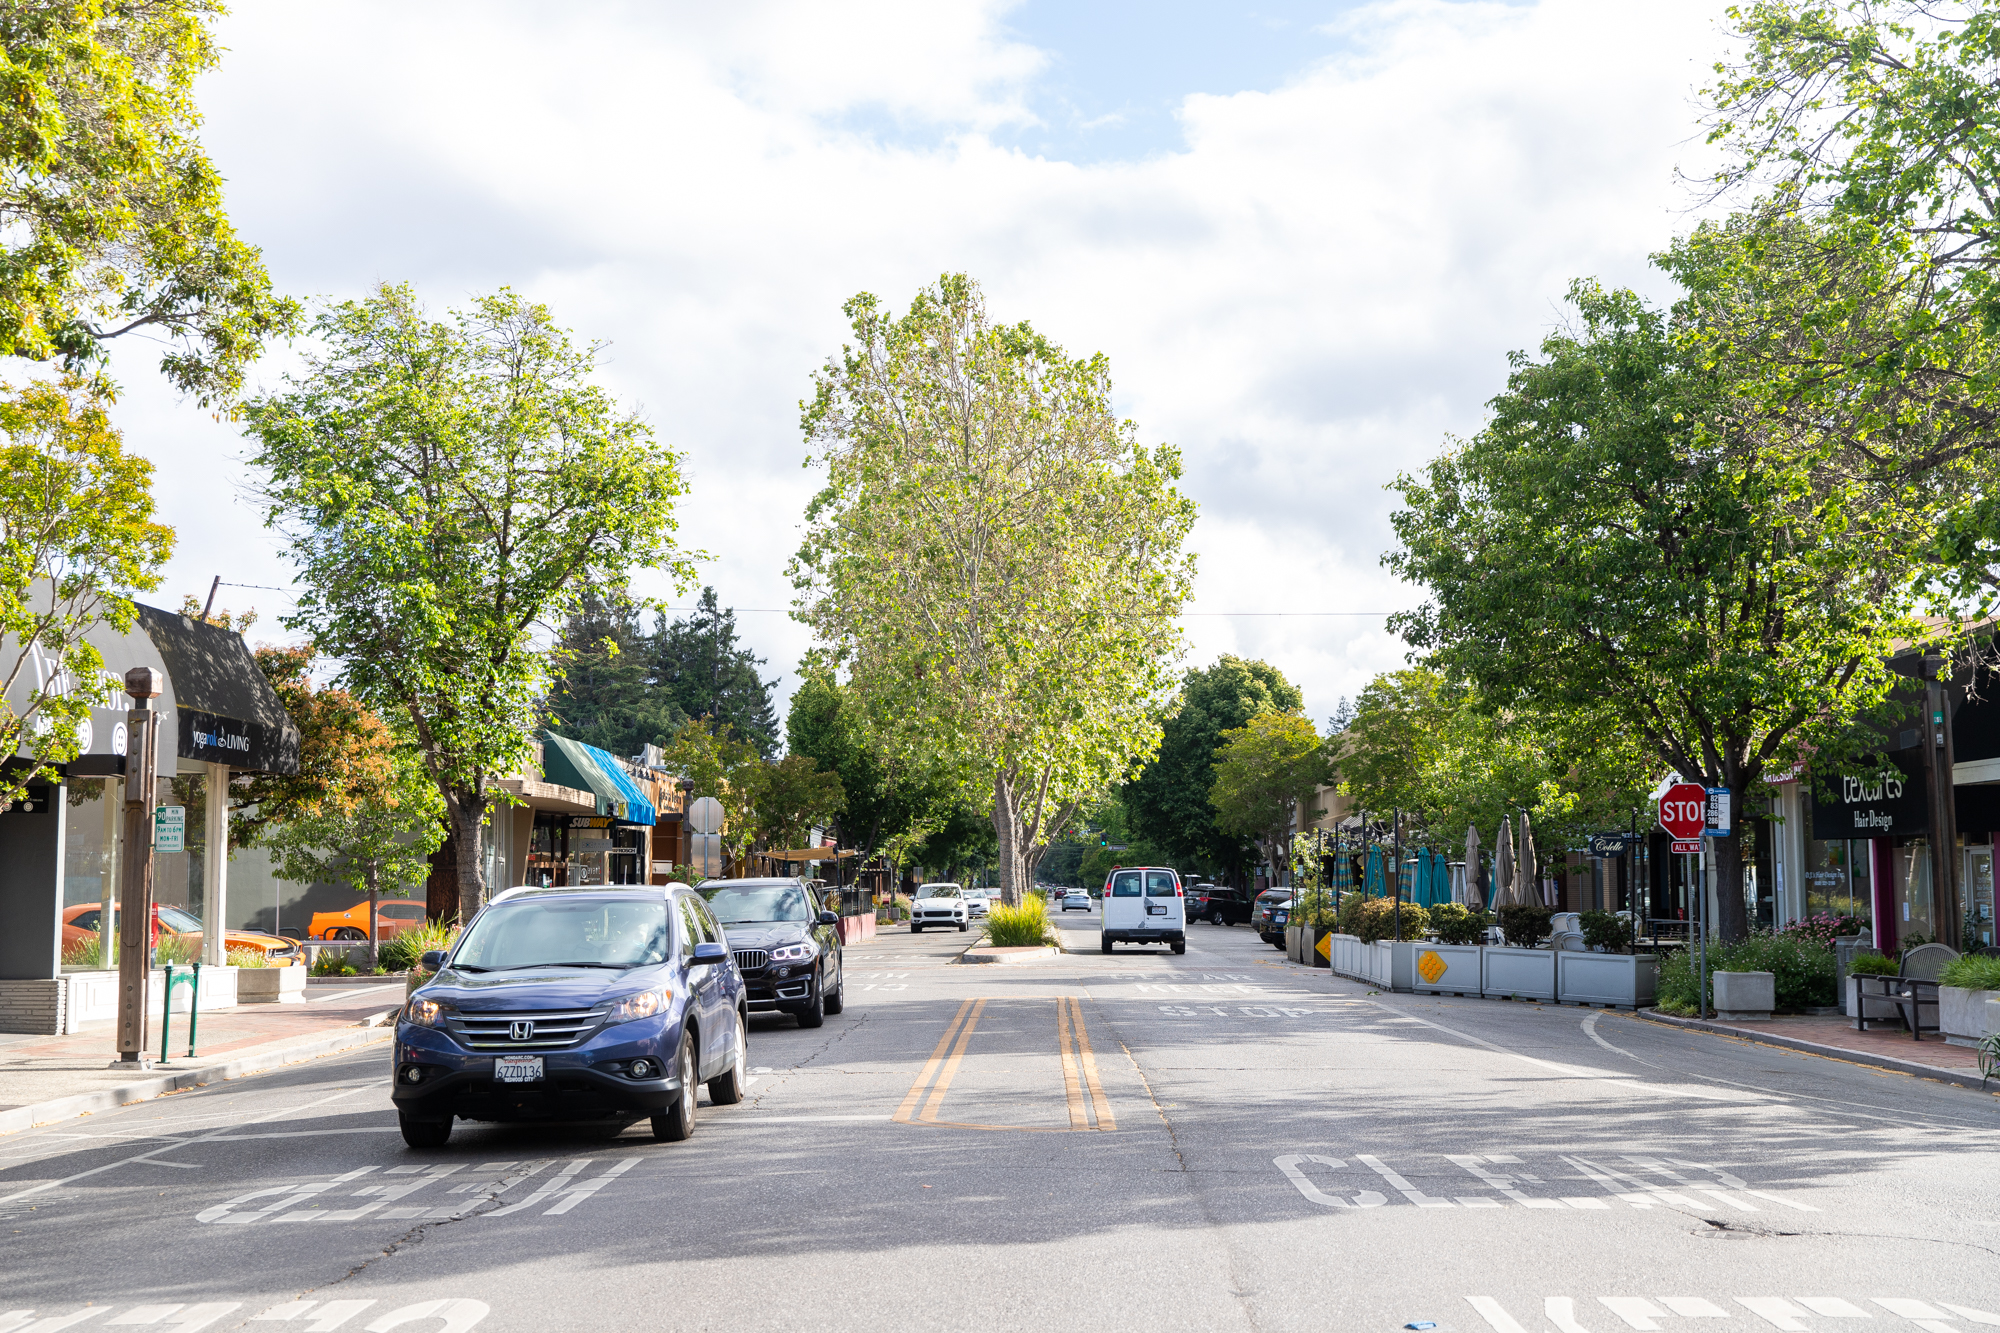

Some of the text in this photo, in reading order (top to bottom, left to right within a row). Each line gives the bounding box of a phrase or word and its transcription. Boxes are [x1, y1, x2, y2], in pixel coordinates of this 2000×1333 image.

[193, 730, 249, 751] yogarok LIVING
[157, 811, 166, 821] 90
[1663, 801, 1706, 822] STOP
[569, 817, 614, 828] SUBWAY
[1854, 809, 1893, 832] Hair Design
[1135, 984, 1263, 994] KEEP
[1157, 1005, 1314, 1018] STOP
[497, 1065, 542, 1078] 6ZZD136
[1272, 1154, 1821, 1212] CLEAR
